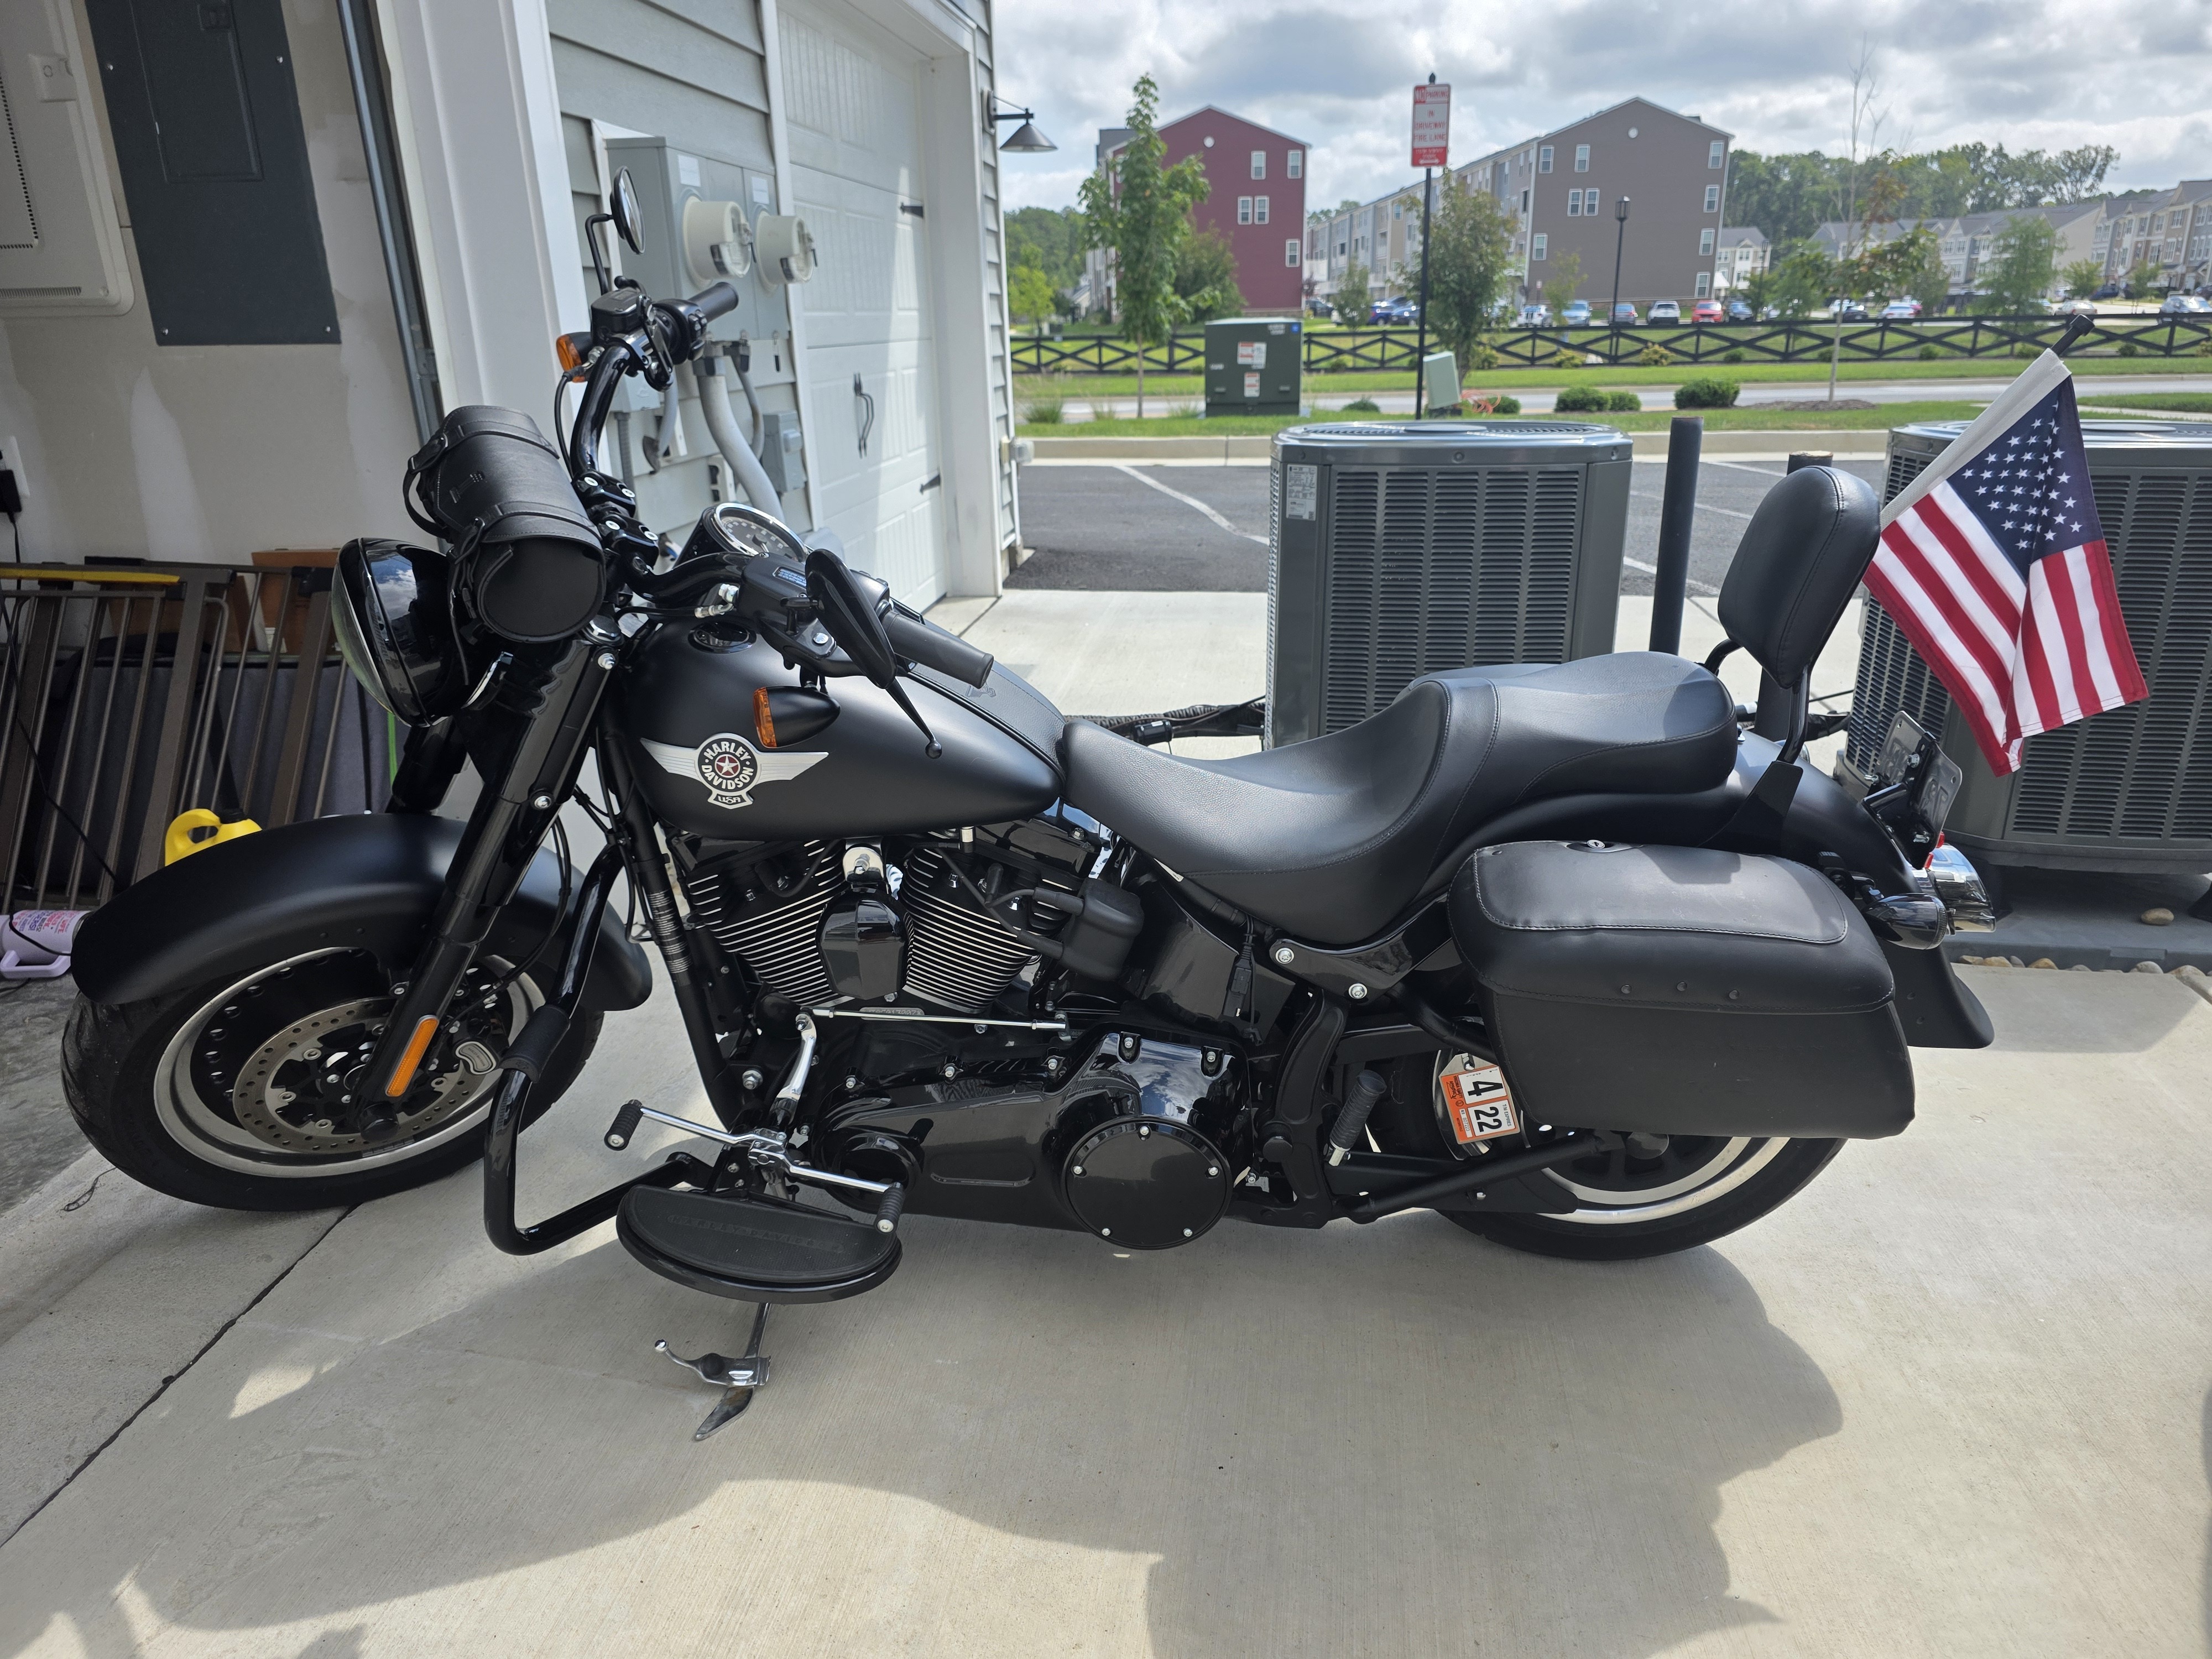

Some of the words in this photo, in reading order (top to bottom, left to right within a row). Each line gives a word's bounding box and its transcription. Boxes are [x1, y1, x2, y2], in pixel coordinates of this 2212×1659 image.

[1426, 91, 1448, 99] PARKING
[1429, 133, 1446, 142] LANE
[703, 741, 751, 761] HARLEY
[701, 765, 754, 790] DAVIDSON
[718, 796, 741, 804] USA
[1467, 1081, 1504, 1097] 4
[1474, 1106, 1503, 1133] 22
